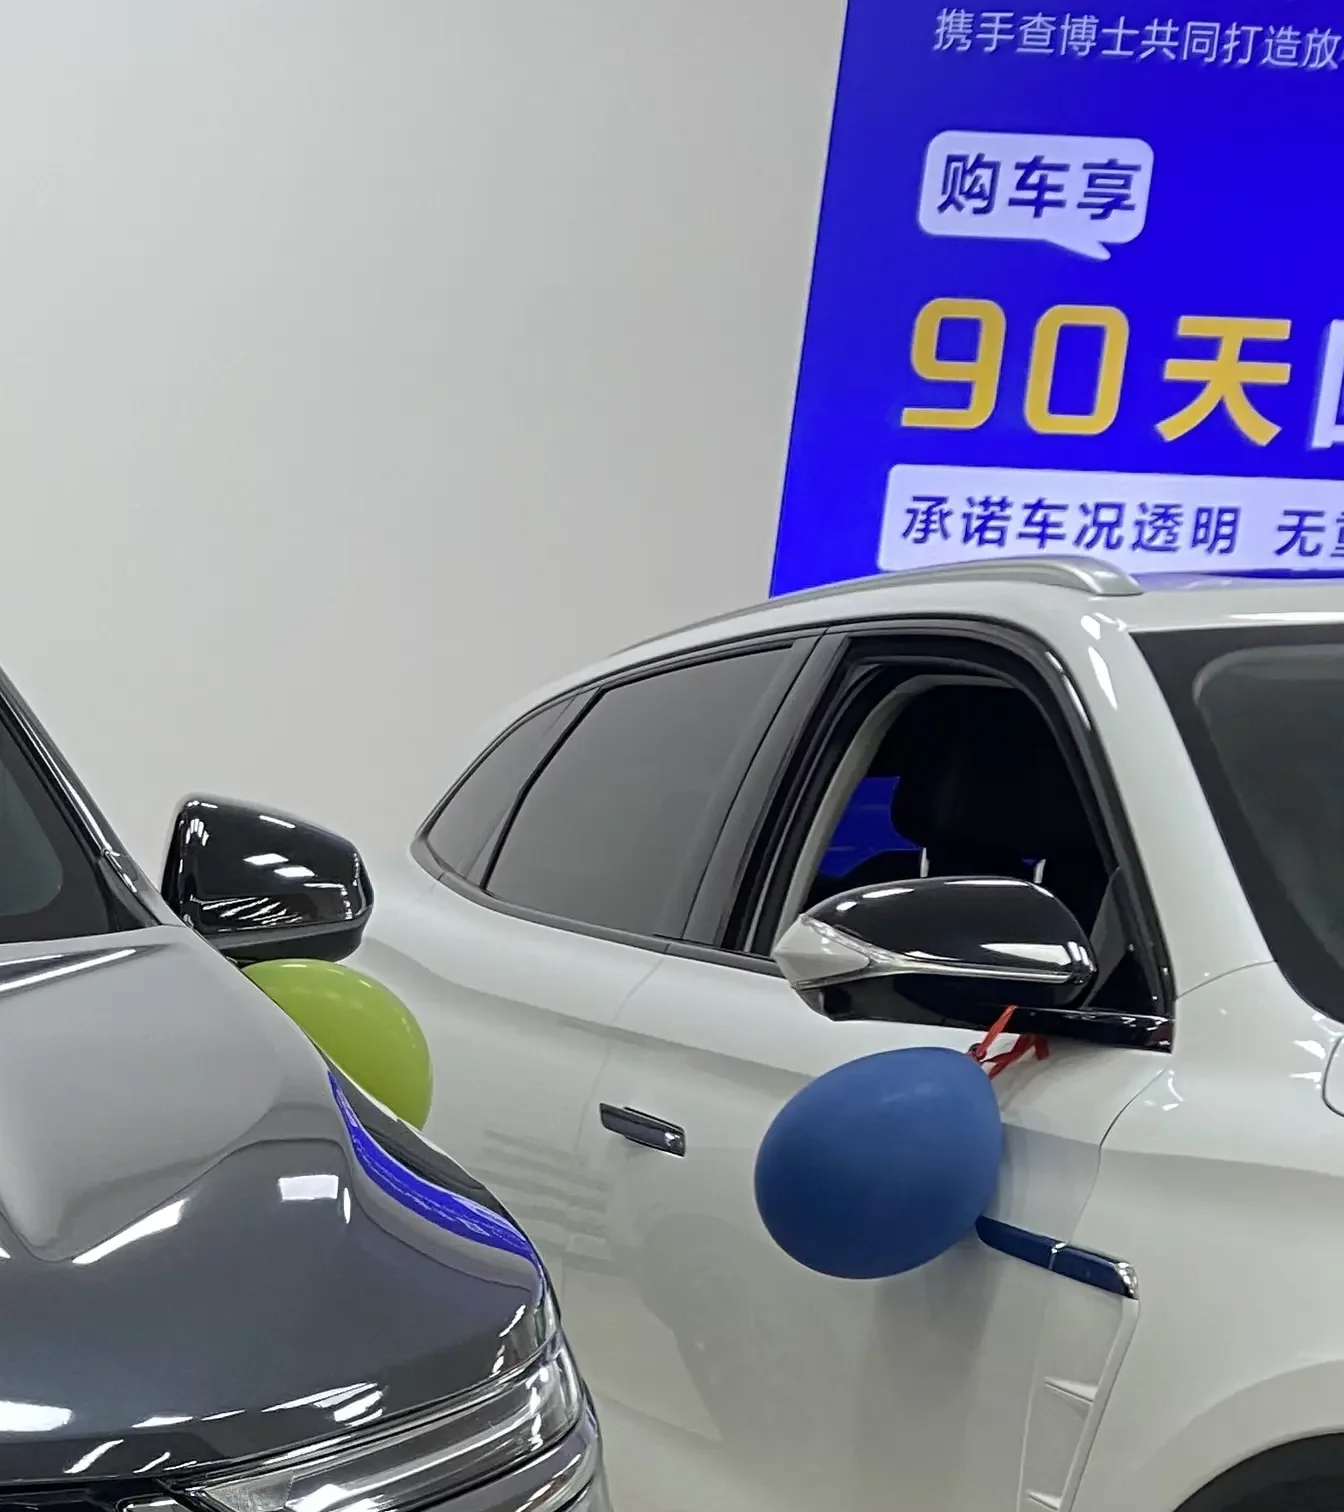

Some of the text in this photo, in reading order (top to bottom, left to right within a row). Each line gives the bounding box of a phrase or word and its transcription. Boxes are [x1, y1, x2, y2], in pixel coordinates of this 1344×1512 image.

[933, 7, 1344, 69] 携手查博士共同打造放
[936, 152, 1143, 220] 购车享
[900, 495, 1241, 556] 承诺车况透明
